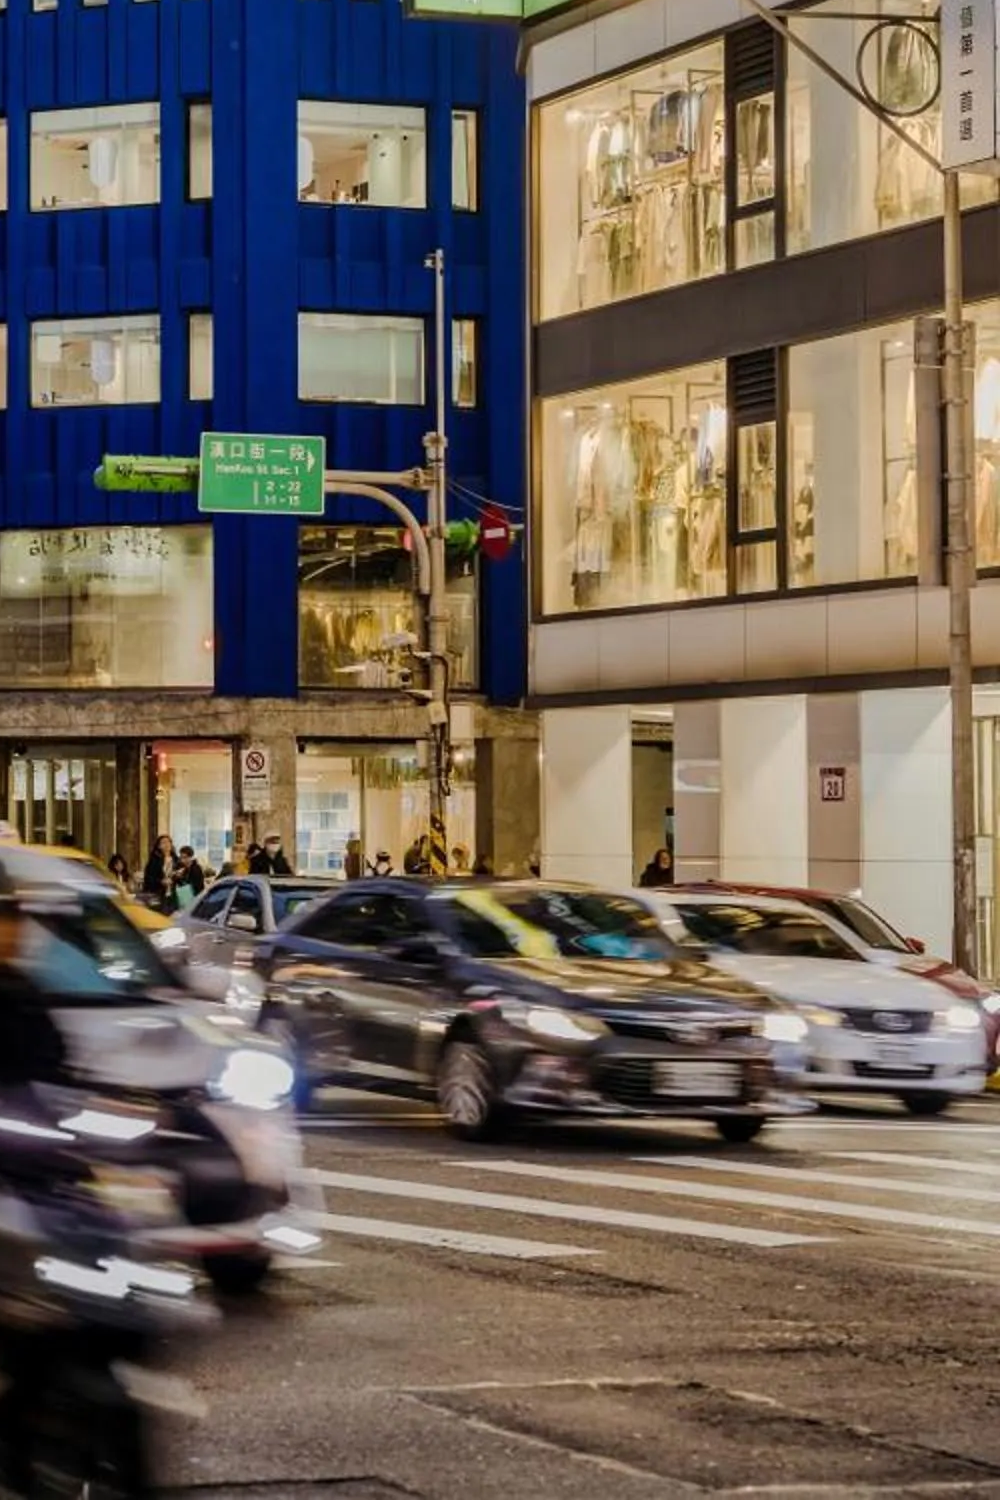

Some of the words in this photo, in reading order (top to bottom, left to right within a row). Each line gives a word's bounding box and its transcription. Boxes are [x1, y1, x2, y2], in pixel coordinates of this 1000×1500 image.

[210, 441, 305, 461] 漢口街一段
